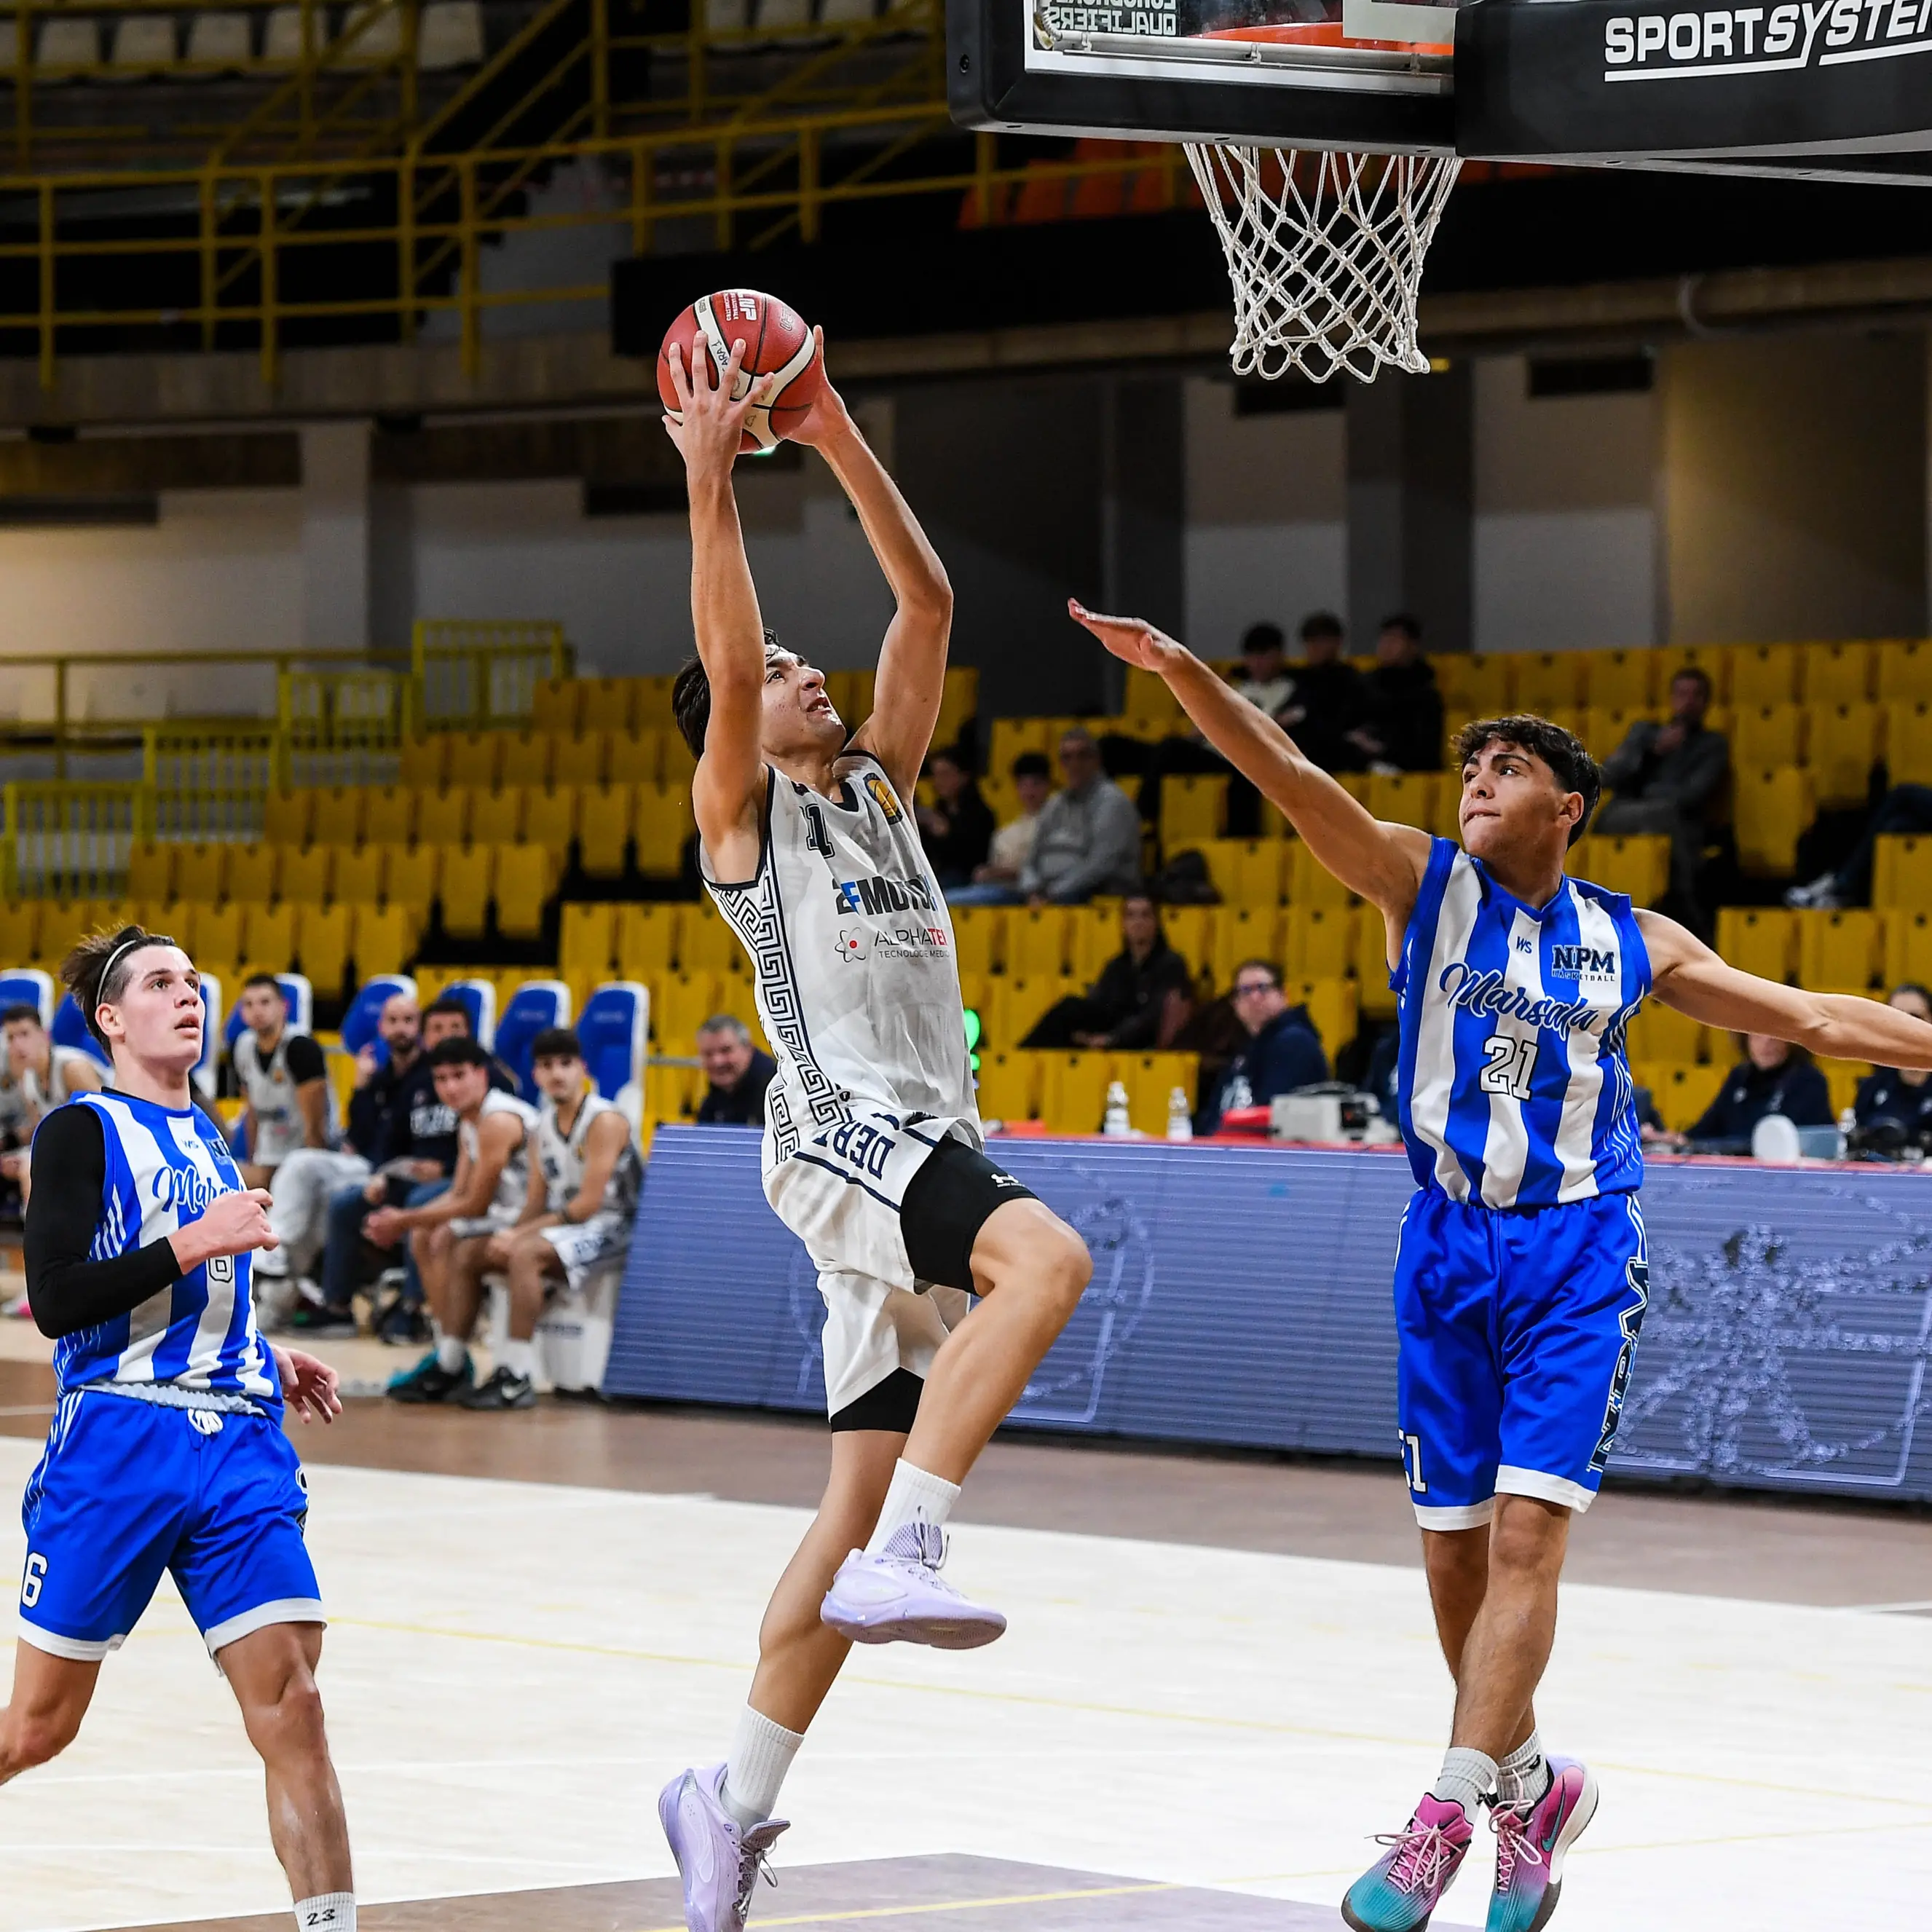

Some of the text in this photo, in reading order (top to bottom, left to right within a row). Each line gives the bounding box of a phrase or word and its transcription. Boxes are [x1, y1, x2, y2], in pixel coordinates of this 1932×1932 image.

[1515, 937, 1533, 955] WS
[1552, 945, 1615, 974] NPM
[1552, 969, 1615, 982] BASKETBALL
[1439, 963, 1599, 1041] Marsala
[1479, 1035, 1539, 1101] 21
[1397, 1428, 1427, 1493] 1
[21, 1551, 48, 1607] 6
[307, 1908, 336, 1926] 23
